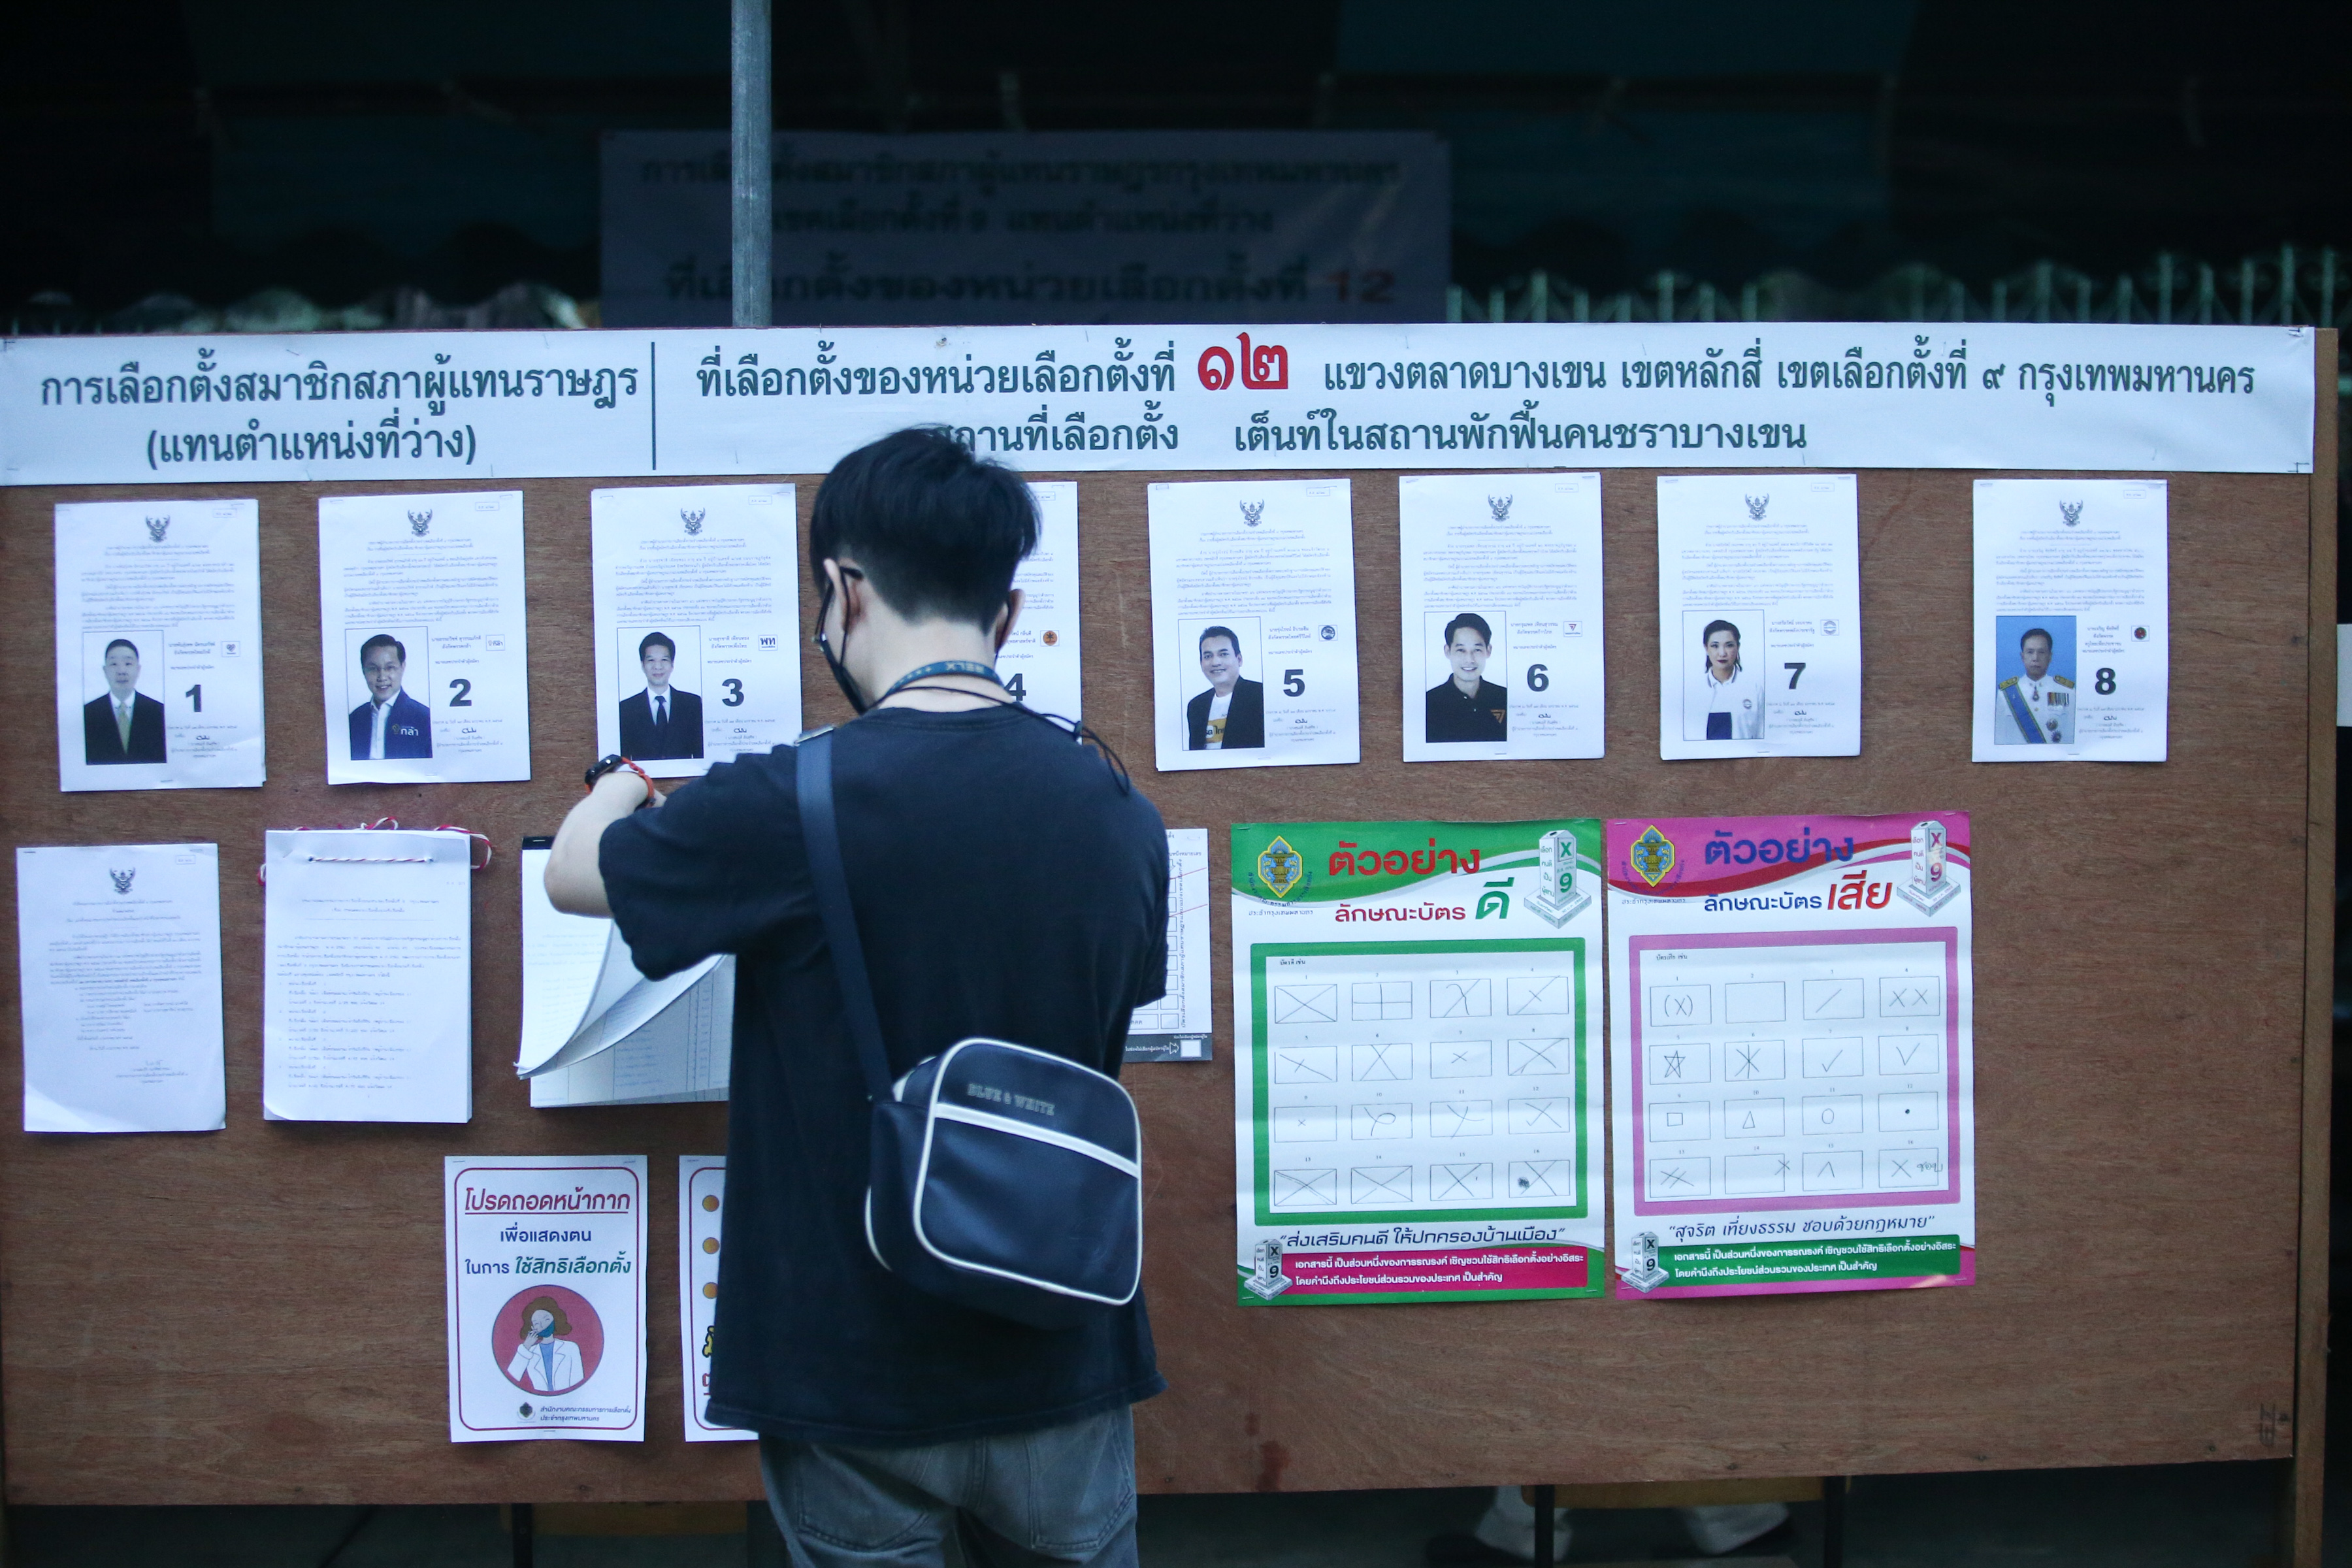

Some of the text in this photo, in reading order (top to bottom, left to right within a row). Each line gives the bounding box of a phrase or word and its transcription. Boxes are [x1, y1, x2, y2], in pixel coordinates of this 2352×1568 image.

[1328, 269, 1397, 304] 12
[697, 332, 2255, 406] ที่เลือกตั้งของหน่วยเลือกตั้งที่ ๑๒ แขวงตลาดบางเขน เขตหลักสี่ เขตเลือกตั้งที่ ๙ กรุงเทพมหานคร
[42, 348, 637, 417] การเลือกตั้งสมาชิกสภาผู้แทนราษฎร
[147, 407, 476, 469] (แทนตำแหน่งที่ว่าง)
[1235, 400, 1806, 451] เต็นท์ในสถานพักฟื้นคนชราบางเขน
[760, 637, 776, 645] พท
[1004, 673, 1026, 701] 4
[1283, 669, 1305, 697] 5
[1527, 663, 1549, 692] 6
[1784, 662, 1806, 690] 7
[2095, 668, 2116, 695] 8
[186, 684, 202, 713] 1
[449, 678, 472, 707] 2
[721, 678, 744, 707] 3
[400, 726, 419, 736] กล้า
[1560, 841, 1572, 858] X
[1705, 828, 1854, 866] ตัวอย่าง
[1931, 832, 1942, 847] X
[1329, 838, 1480, 876] ตัวอย่าง
[1560, 873, 1573, 893] 9
[1931, 862, 1942, 882] 9
[1335, 903, 1466, 923] ลักษณะบัตร
[1475, 877, 1514, 920] ดี
[1704, 892, 1821, 911] ลักษณะบัตร
[1827, 870, 1893, 911] เสีย
[968, 1084, 1002, 1103] BLUE
[1015, 1094, 1055, 1116] WHITE
[465, 1186, 630, 1211] โปรดถอดหน้ากาก
[500, 1222, 592, 1242] เพื่อแสดงตน
[1723, 1218, 1796, 1236] เที่ยงธรรม
[1270, 1246, 1279, 1256] X
[1646, 1239, 1655, 1249] X
[1674, 1238, 1957, 1262] เอกสารนี้ เป็นส่วนหนึ่งของการรณรงค์ เชิญชวนใช้สิทธิเลือกตั้งอย่างอิสระ
[465, 1251, 631, 1275] ในการ ใช้สิทธิเลือกตั้ง
[1269, 1265, 1279, 1279] 9
[1295, 1250, 1584, 1269] เอกสารนี้ เป็นส่วนหนึ่งของการรณรงค์ เชิญชวนใช้สิทธิเลือกตั้งอย่างอิสระ
[1646, 1258, 1656, 1271] 9
[1675, 1262, 1878, 1279] โดยคำนึงถึงประโยชน์ส่วนรวมของประเทศ เป็นสำคัญ
[1295, 1271, 1503, 1286] โดยคำนึงถึงประโยชน์ส่วนรวมของประเทศ เป็นสำคัญ
